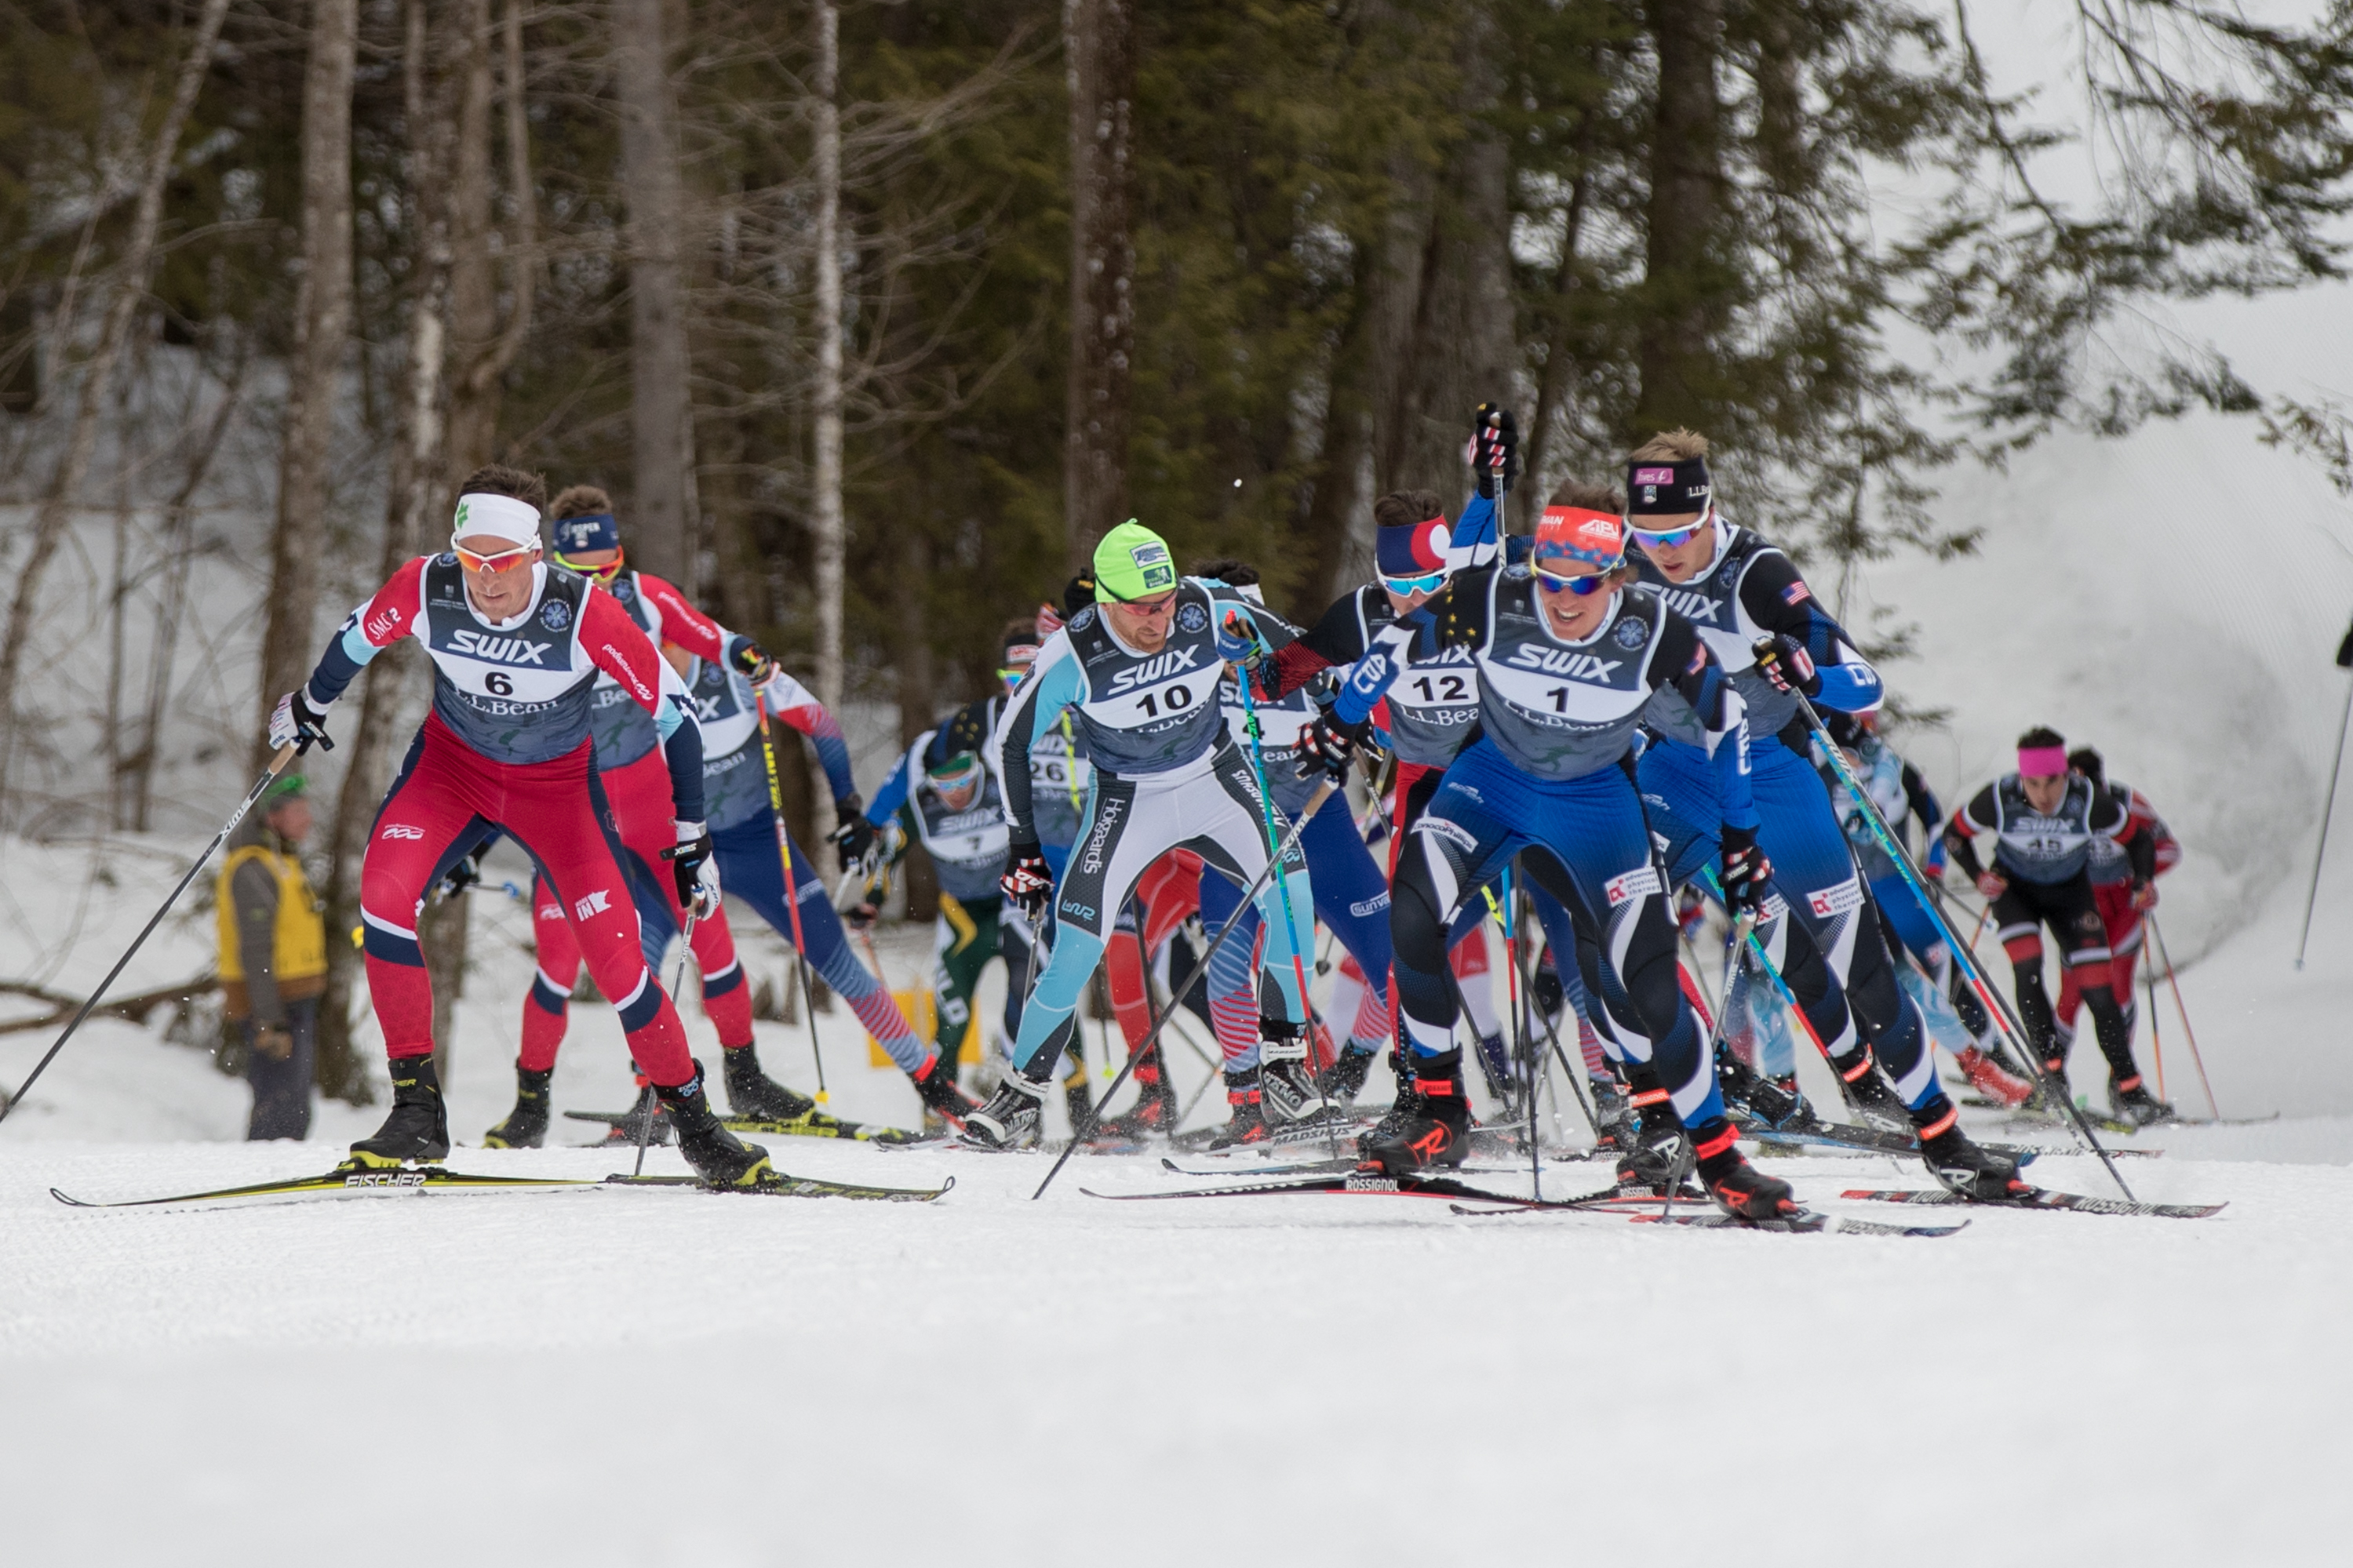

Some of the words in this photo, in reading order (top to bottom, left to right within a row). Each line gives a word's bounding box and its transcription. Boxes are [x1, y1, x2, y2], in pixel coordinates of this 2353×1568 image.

[446, 629, 552, 665] SWIX
[1107, 644, 1199, 696] SWIX
[1508, 642, 1615, 683] SWIX
[485, 671, 514, 697] 6
[1412, 675, 1470, 702] 12
[1135, 685, 1193, 718] 10
[1546, 686, 1569, 713] 1
[1401, 705, 1479, 726] L.L.Bea
[1029, 759, 1065, 783] 26
[965, 835, 983, 851] 7
[1273, 1126, 1351, 1146] MADSHUS
[344, 1173, 427, 1188] FISCHER
[1346, 1177, 1401, 1193] ROSSIGNOL
[2073, 1195, 2157, 1217] ROSSIGNOL
